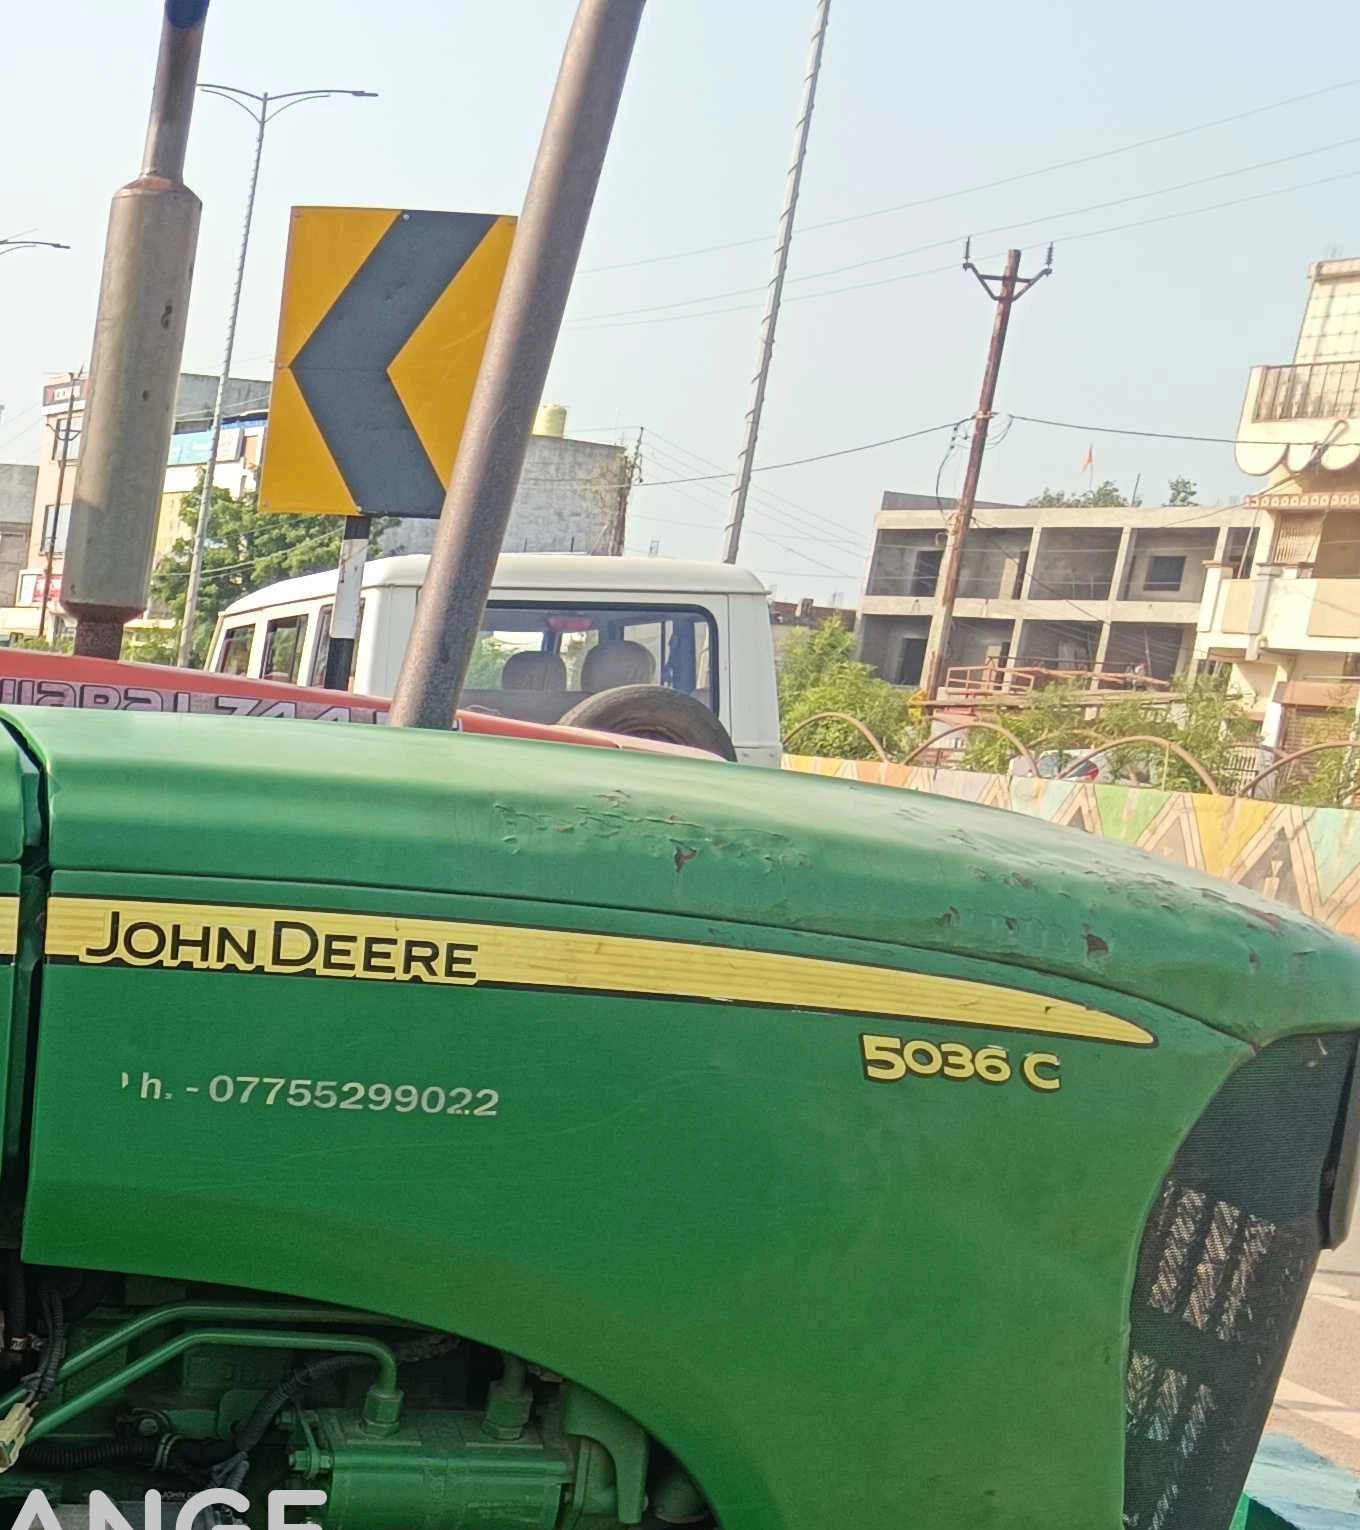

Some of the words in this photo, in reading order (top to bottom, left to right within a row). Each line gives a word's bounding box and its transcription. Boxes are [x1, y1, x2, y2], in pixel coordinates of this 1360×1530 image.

[85, 911, 257, 965] JOHN
[271, 920, 479, 979] DEERE
[860, 1033, 1013, 1083] 5036
[1022, 1052, 1061, 1091] C
[208, 1074, 500, 1117] 07755299022
